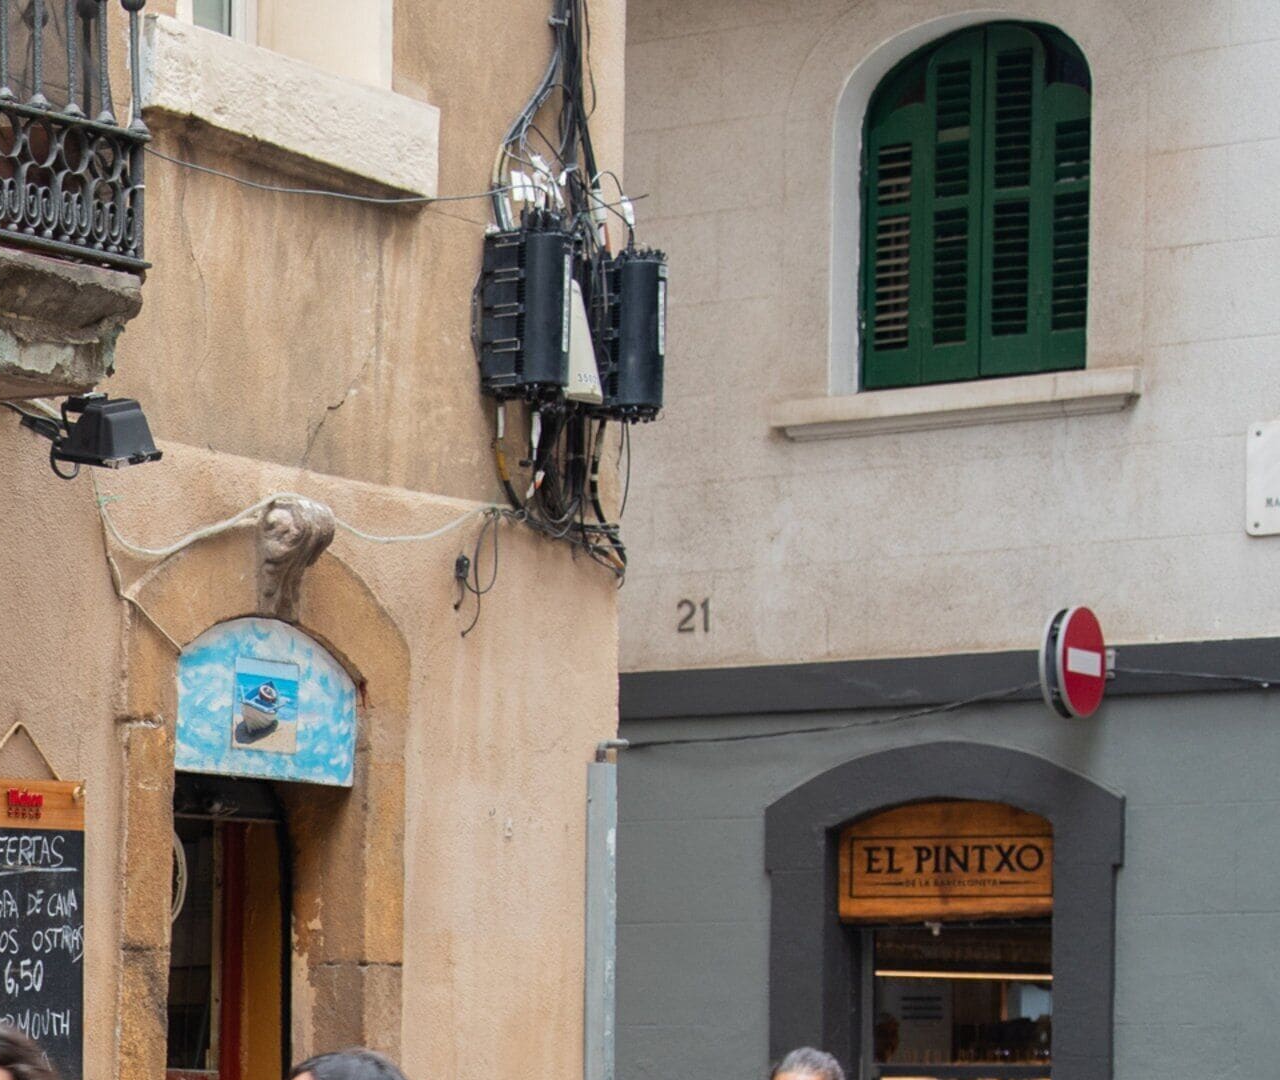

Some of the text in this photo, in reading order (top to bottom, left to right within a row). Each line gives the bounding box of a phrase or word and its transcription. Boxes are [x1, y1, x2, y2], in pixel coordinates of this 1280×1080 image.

[677, 597, 710, 633] 21
[863, 844, 1044, 874] EL PINTXO
